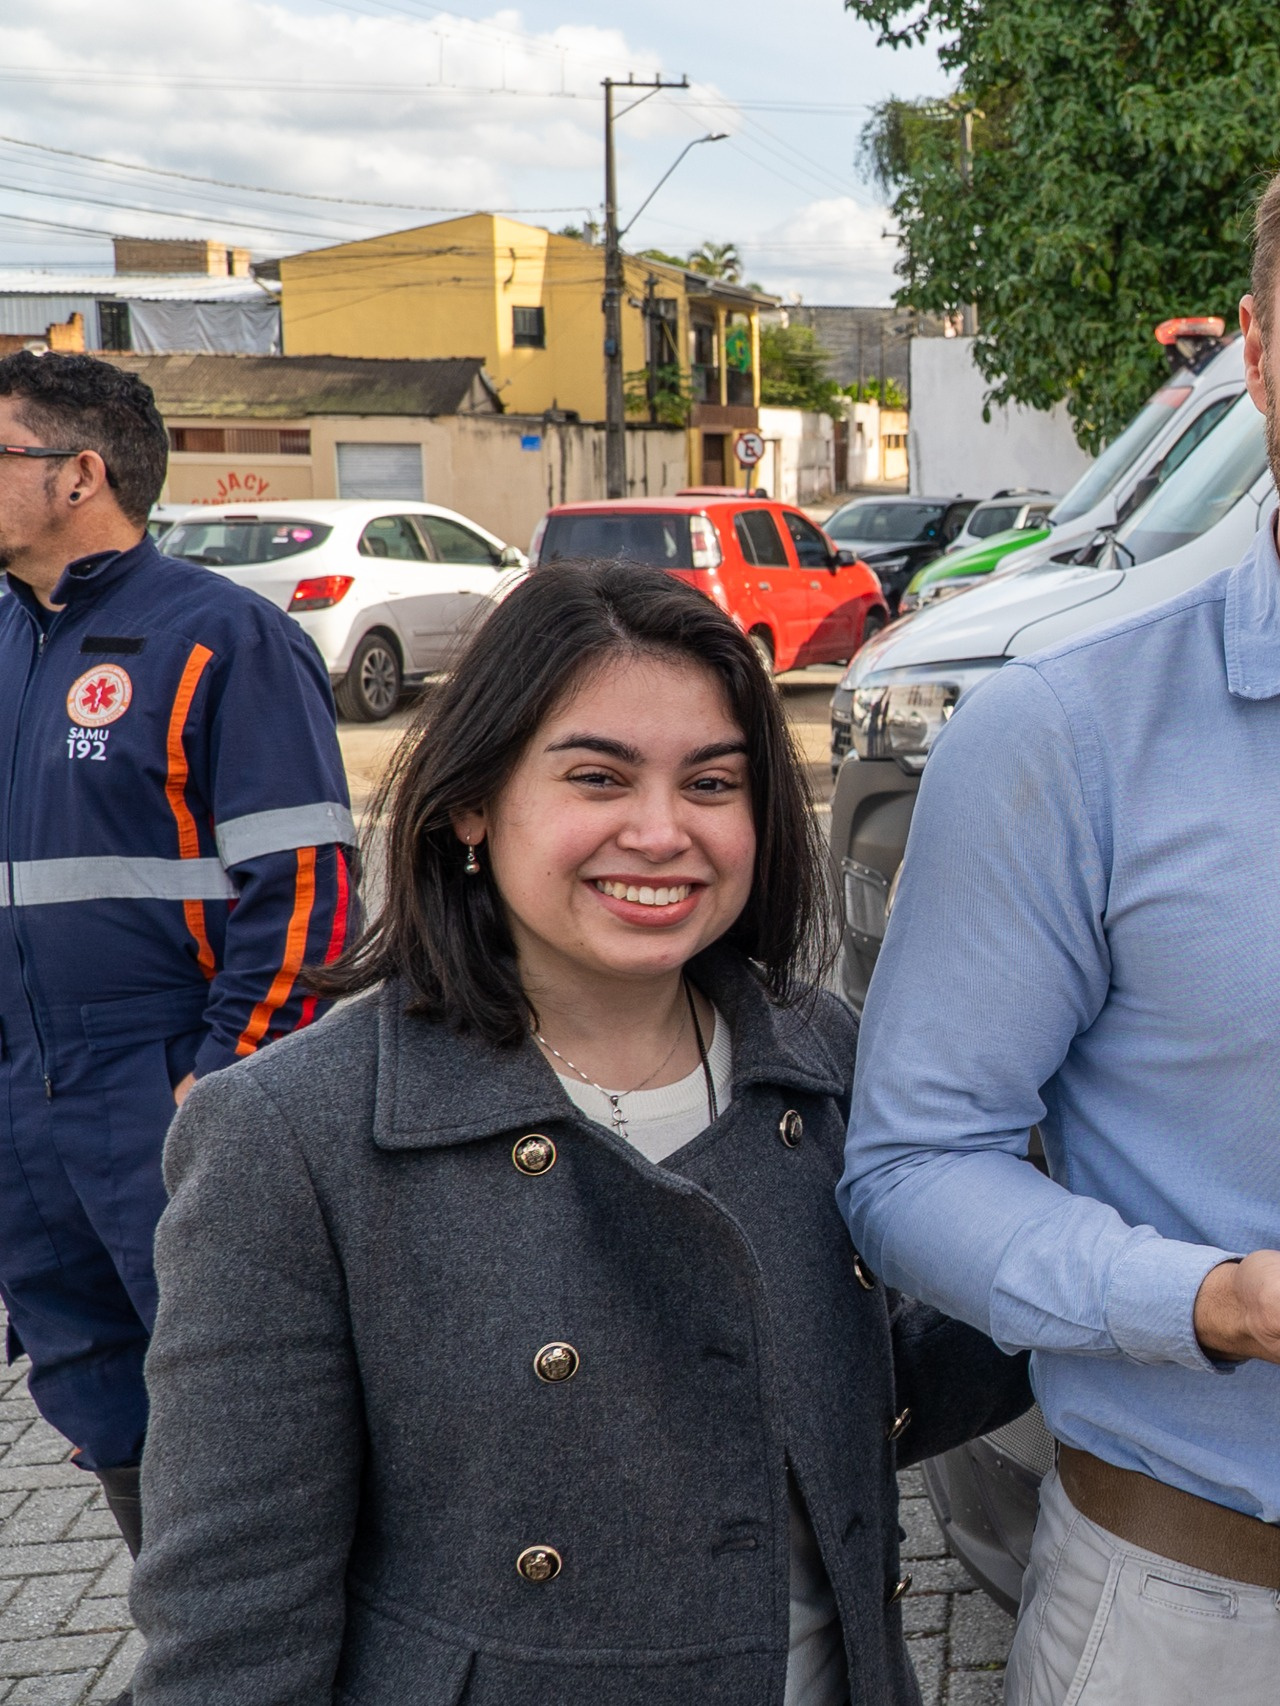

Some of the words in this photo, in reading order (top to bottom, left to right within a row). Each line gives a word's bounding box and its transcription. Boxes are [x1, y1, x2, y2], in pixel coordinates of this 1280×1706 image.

[217, 472, 270, 497] JACY
[68, 727, 109, 741] SAMU
[67, 739, 107, 761] 192
